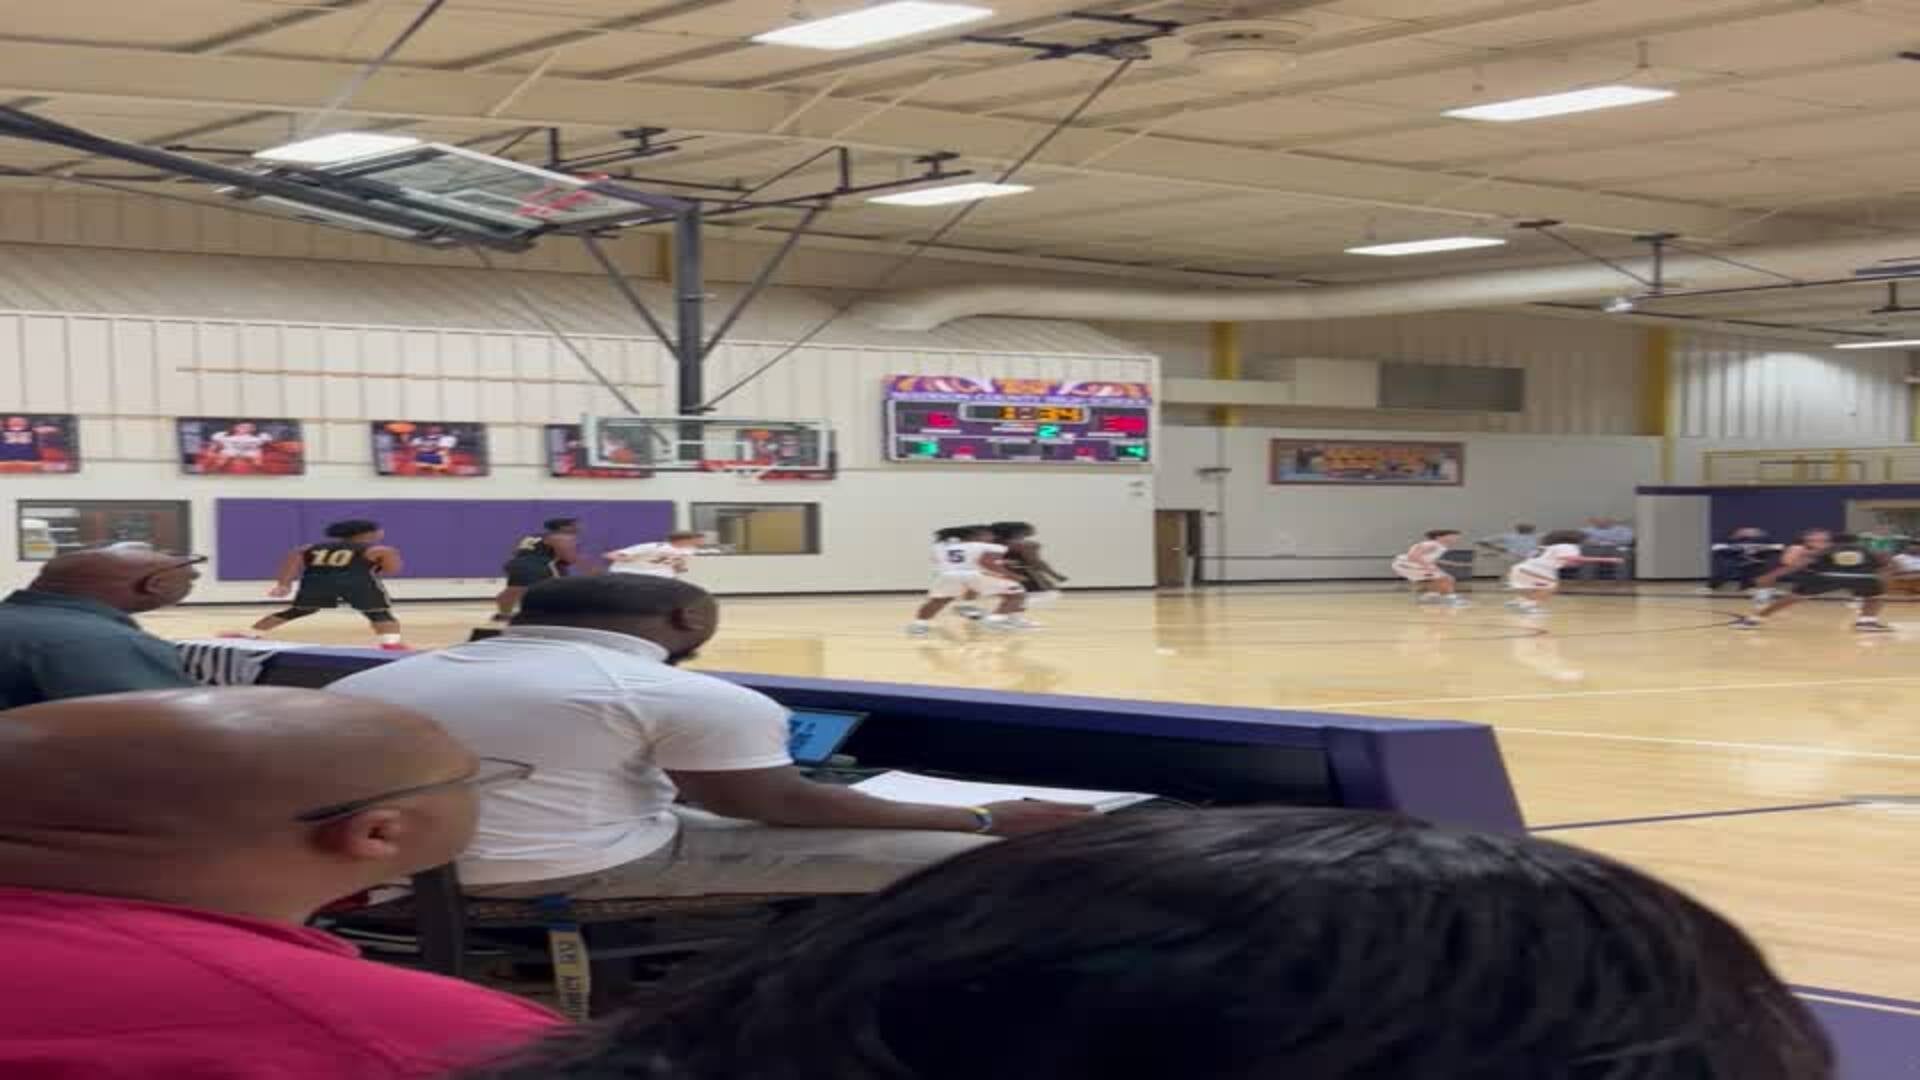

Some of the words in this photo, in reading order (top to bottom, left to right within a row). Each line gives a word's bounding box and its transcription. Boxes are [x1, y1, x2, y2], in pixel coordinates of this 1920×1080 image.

[1037, 424, 1059, 438] 2
[308, 548, 355, 567] 10
[946, 549, 965, 563] 5
